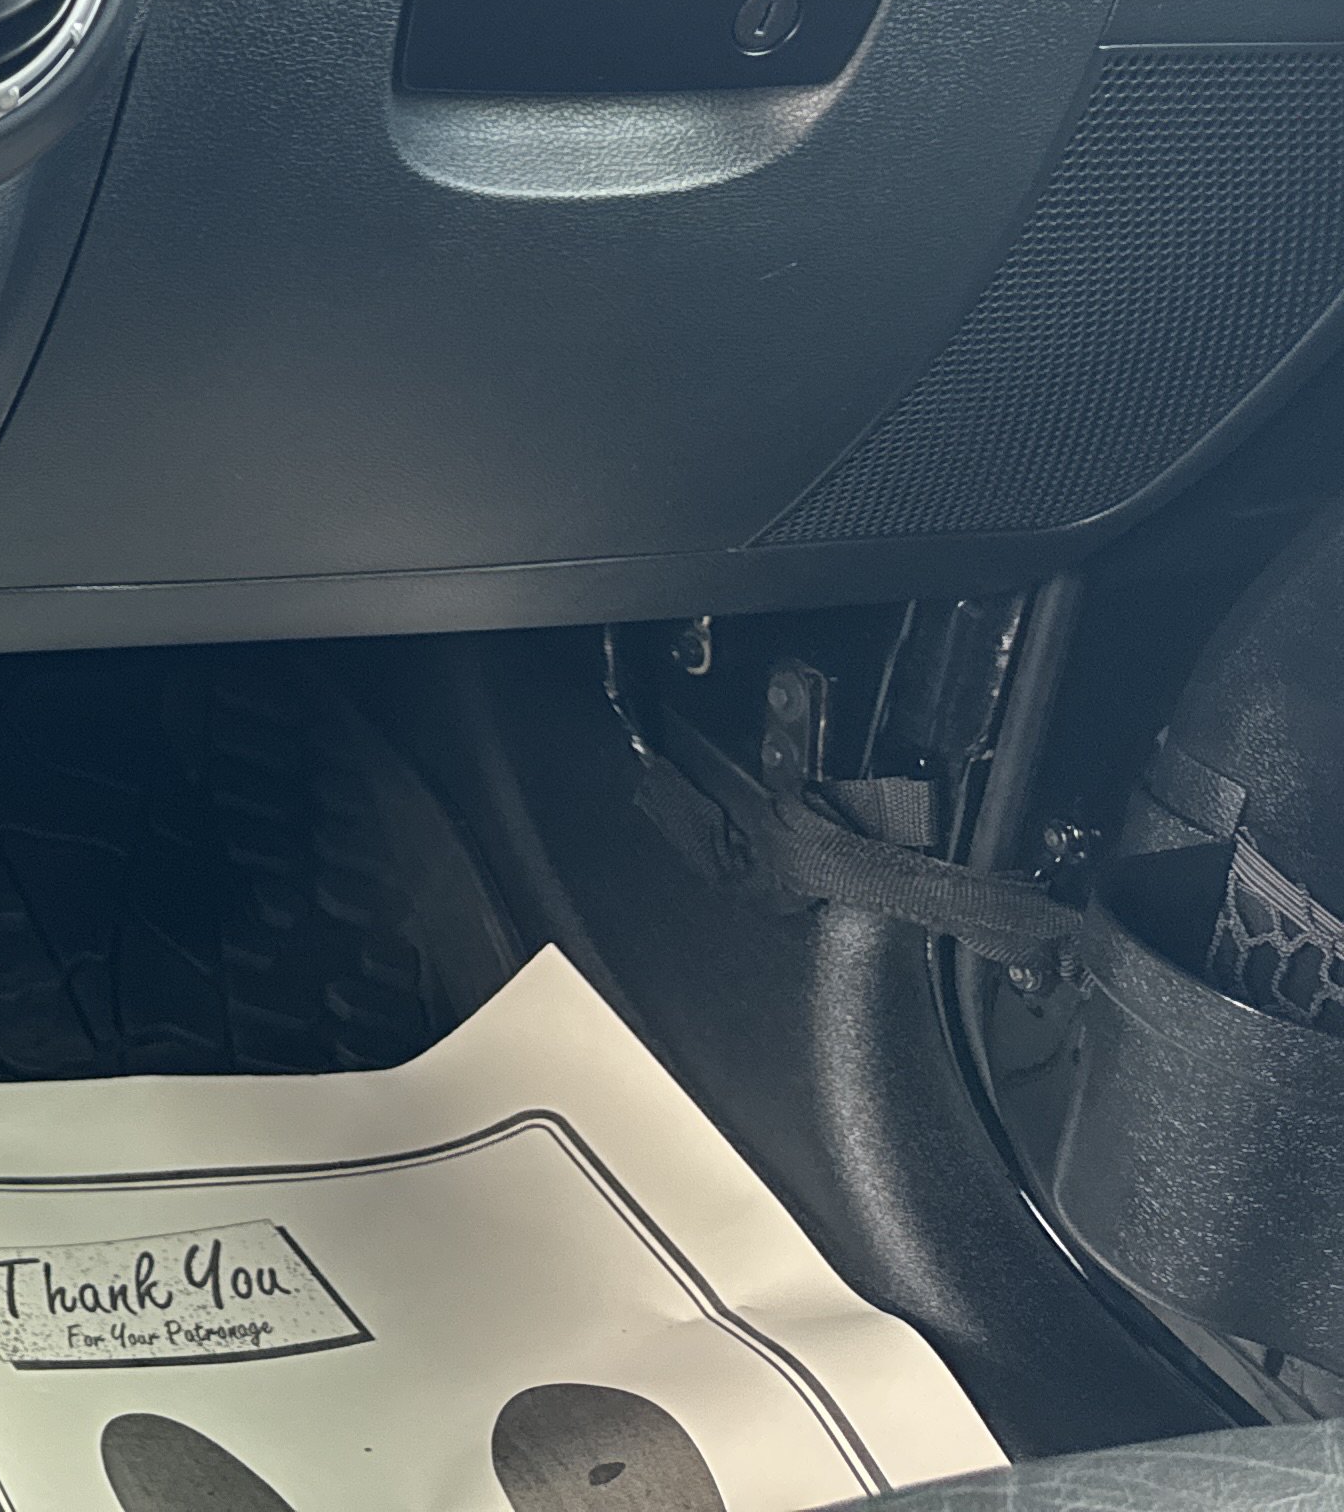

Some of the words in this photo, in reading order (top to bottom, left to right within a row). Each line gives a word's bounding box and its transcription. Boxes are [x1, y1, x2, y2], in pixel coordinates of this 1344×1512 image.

[184, 1239, 292, 1310] You
[67, 1324, 105, 1349] For
[110, 1322, 160, 1349] Your
[165, 1319, 274, 1347] Patronage
